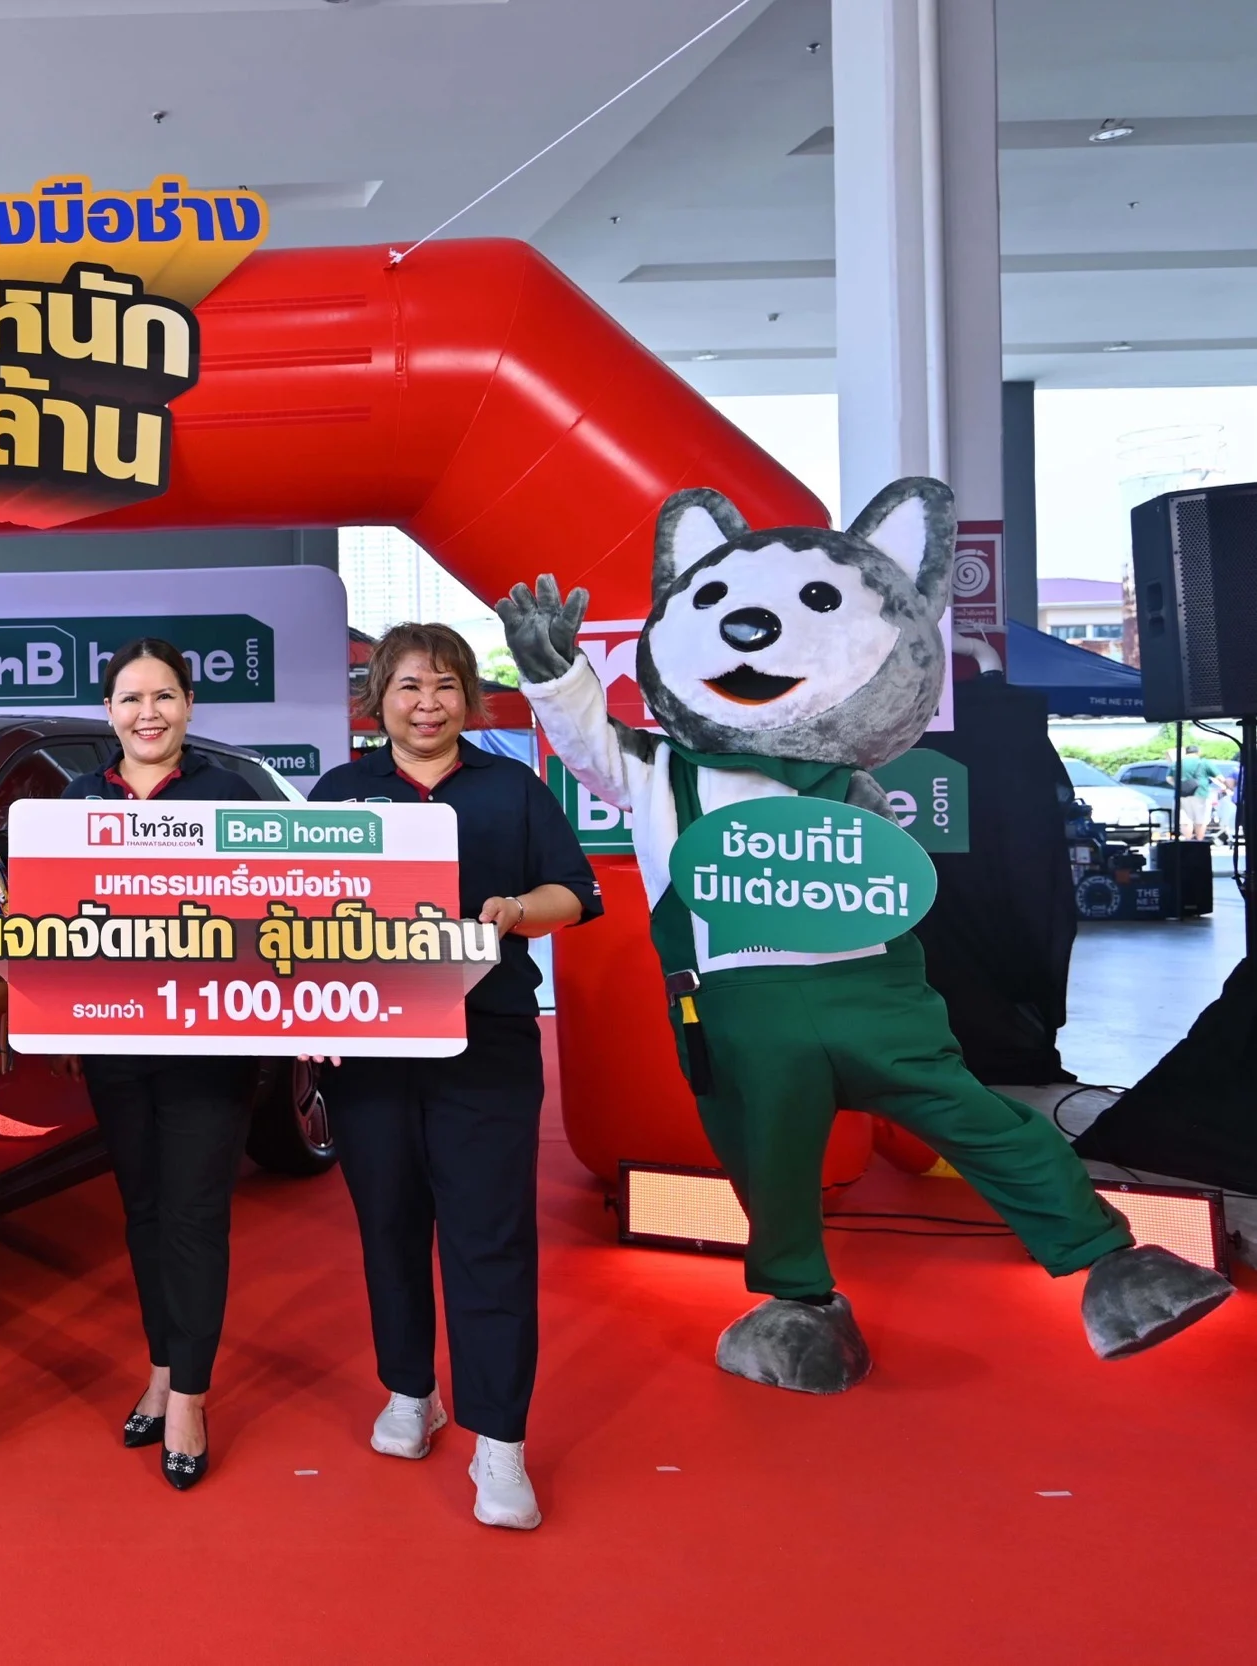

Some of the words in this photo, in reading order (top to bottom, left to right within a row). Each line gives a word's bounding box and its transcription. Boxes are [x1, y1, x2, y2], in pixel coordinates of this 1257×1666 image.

[89, 641, 235, 684] he
[245, 637, 259, 687] .com
[264, 756, 306, 769] ome
[126, 813, 204, 846] ไทวัสดุ
[932, 776, 949, 835] .com
[227, 820, 283, 843] BnB
[293, 821, 364, 844] home
[368, 822, 376, 847] .com
[721, 816, 863, 865] ช้อปที่นี่
[94, 863, 372, 897] มหกรรมเครื่องมือช่าง
[693, 863, 909, 918] มีแต่ของดี!
[1136, 889, 1160, 897] THE
[258, 901, 499, 976] ลุ้นเป็นล้าน
[72, 1002, 144, 1019] รวมกว่า
[157, 980, 403, 1029] 1,100,000.-
